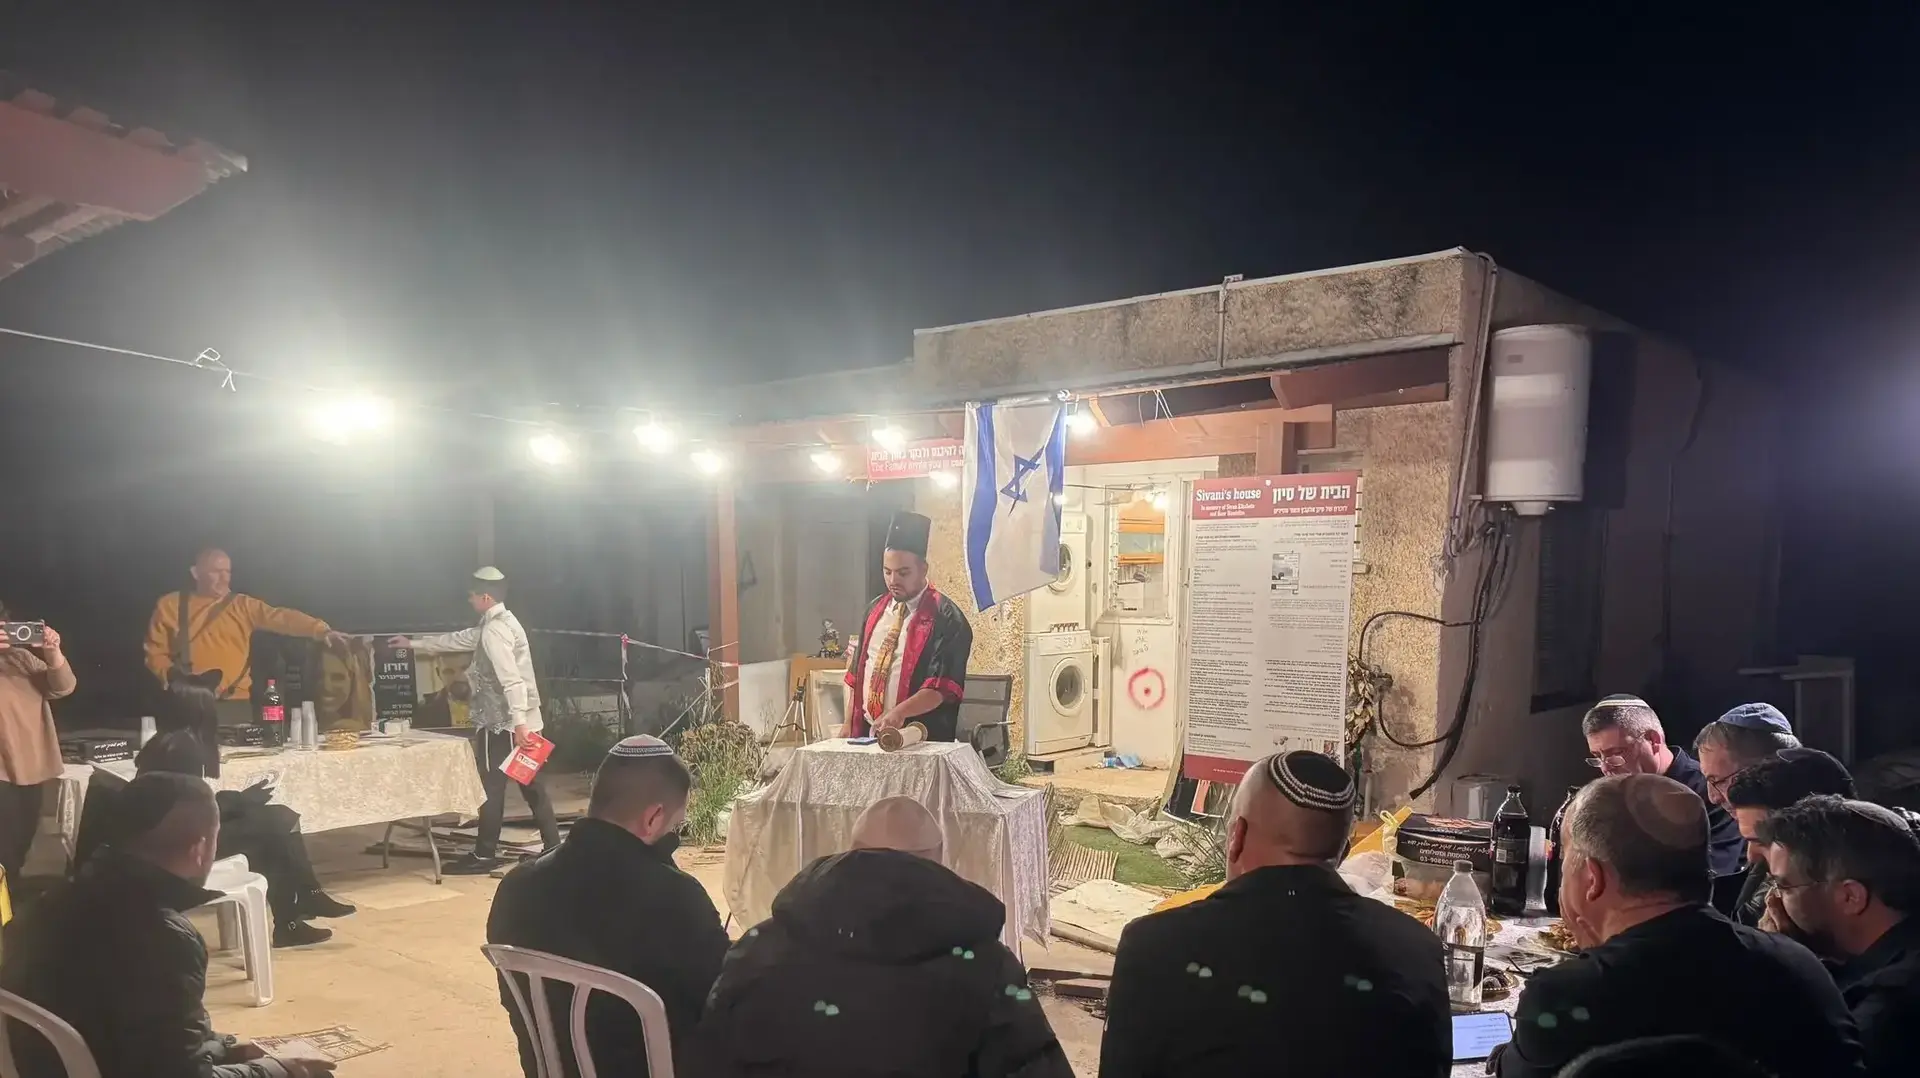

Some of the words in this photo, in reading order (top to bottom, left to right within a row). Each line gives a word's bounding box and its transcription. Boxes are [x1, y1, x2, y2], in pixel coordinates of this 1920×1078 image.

[1233, 487, 1262, 500] house
[1272, 487, 1295, 504] סיון
[1298, 485, 1317, 500] של
[1320, 485, 1351, 499] הבית
[384, 662, 408, 673] דורון
